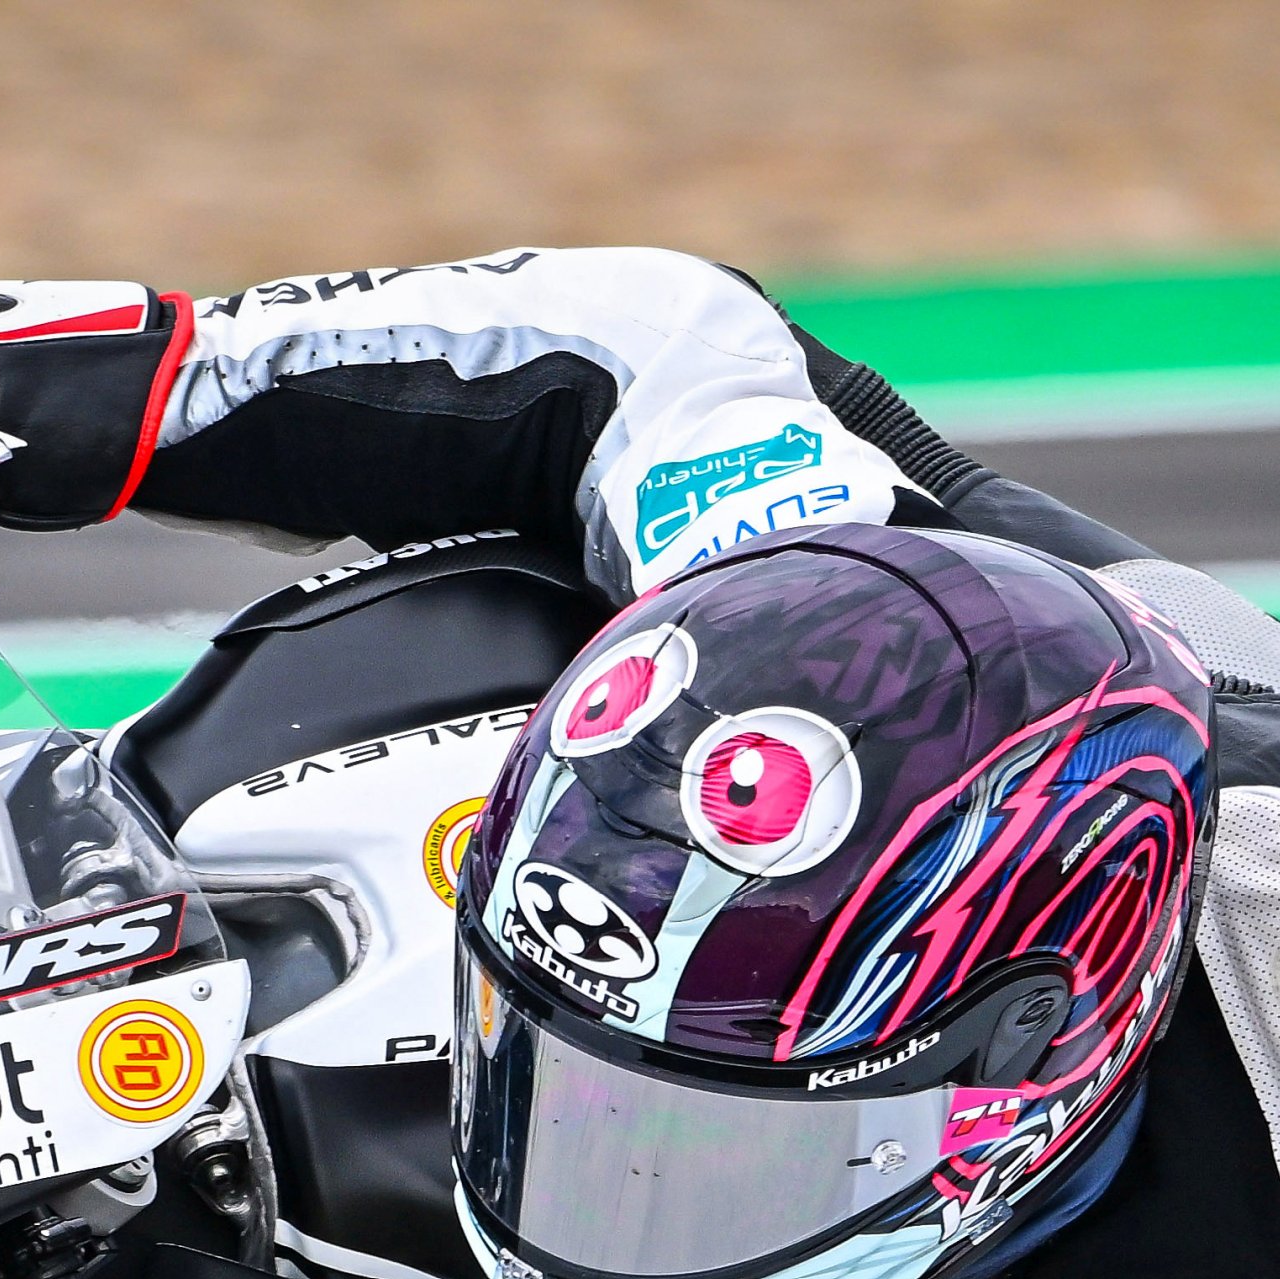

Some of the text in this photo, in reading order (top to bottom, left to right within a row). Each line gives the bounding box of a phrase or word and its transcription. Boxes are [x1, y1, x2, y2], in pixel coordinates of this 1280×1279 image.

[297, 528, 520, 593] DUCATI
[427, 822, 447, 888] lubricants
[504, 913, 637, 1018] Kabuto
[808, 1032, 941, 1091] Kabuto
[950, 1096, 1022, 1138] 74
